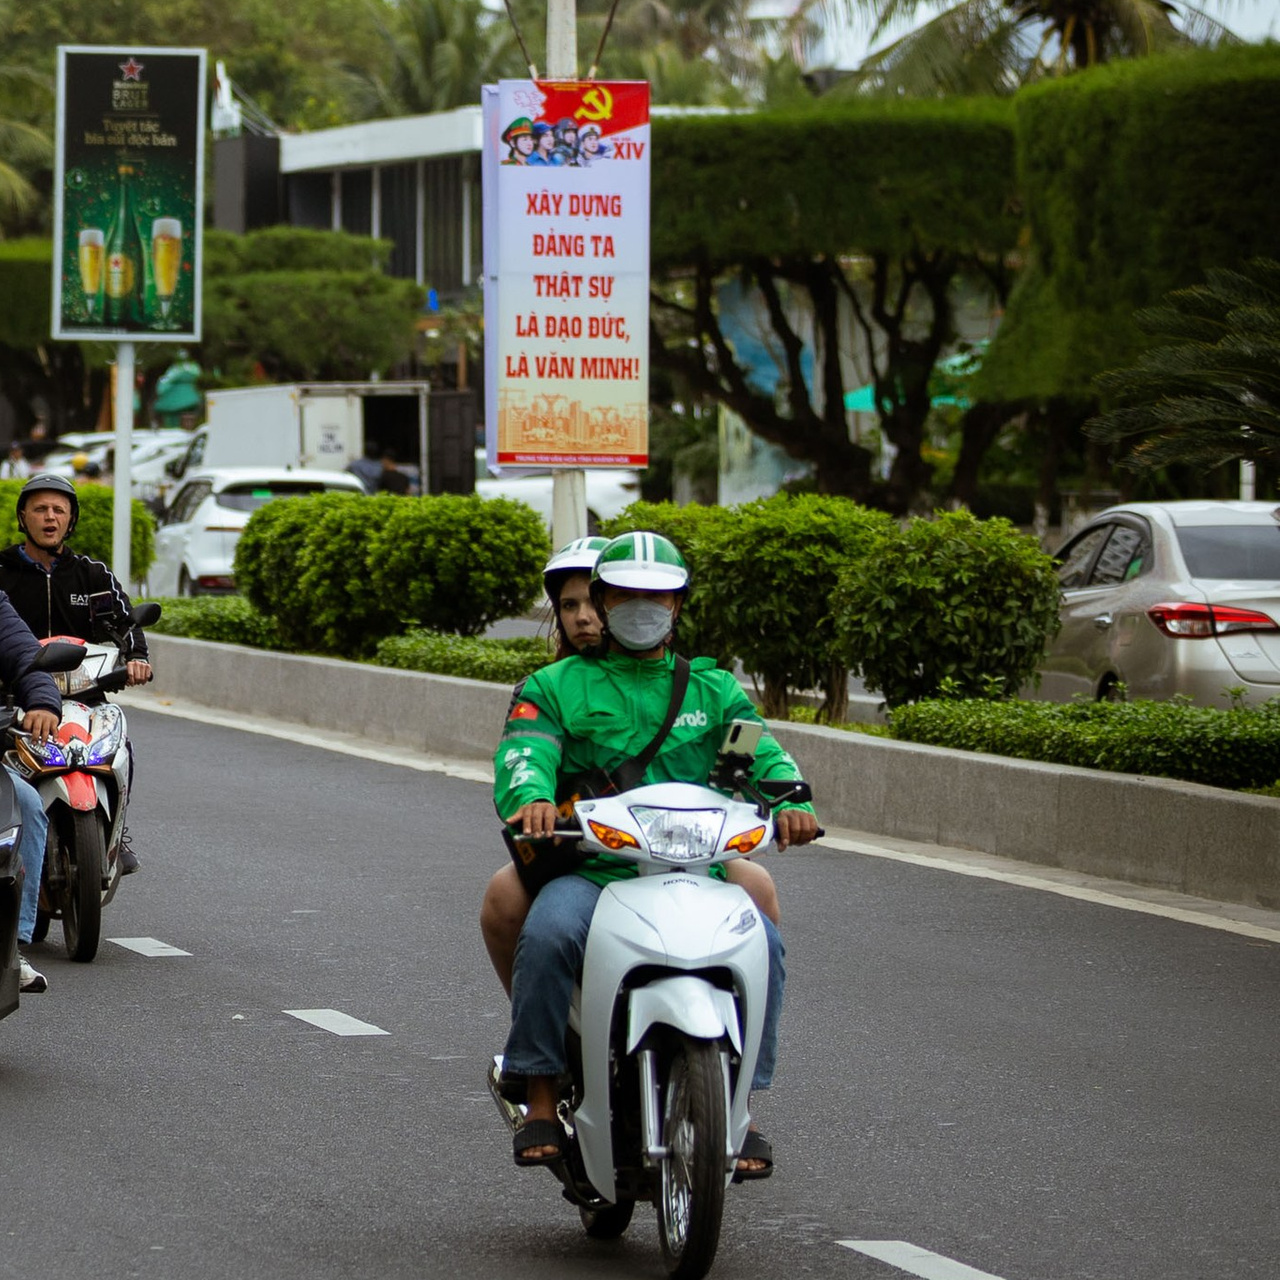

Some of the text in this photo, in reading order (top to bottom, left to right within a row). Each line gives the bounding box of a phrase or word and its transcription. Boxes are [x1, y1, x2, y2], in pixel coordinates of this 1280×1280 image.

[112, 90, 148, 100] BRUT
[613, 142, 645, 160] XIV
[526, 188, 622, 222] XÂY DỰNG
[532, 227, 615, 258] ĐẢNG TA
[533, 270, 615, 303] THẬT SỰ
[516, 310, 630, 343] LÀ ĐẠO ĐỨC,
[505, 350, 639, 380] LÀ VĂN MINH!
[70, 593, 89, 603] EA7
[663, 878, 699, 887] HONDA
